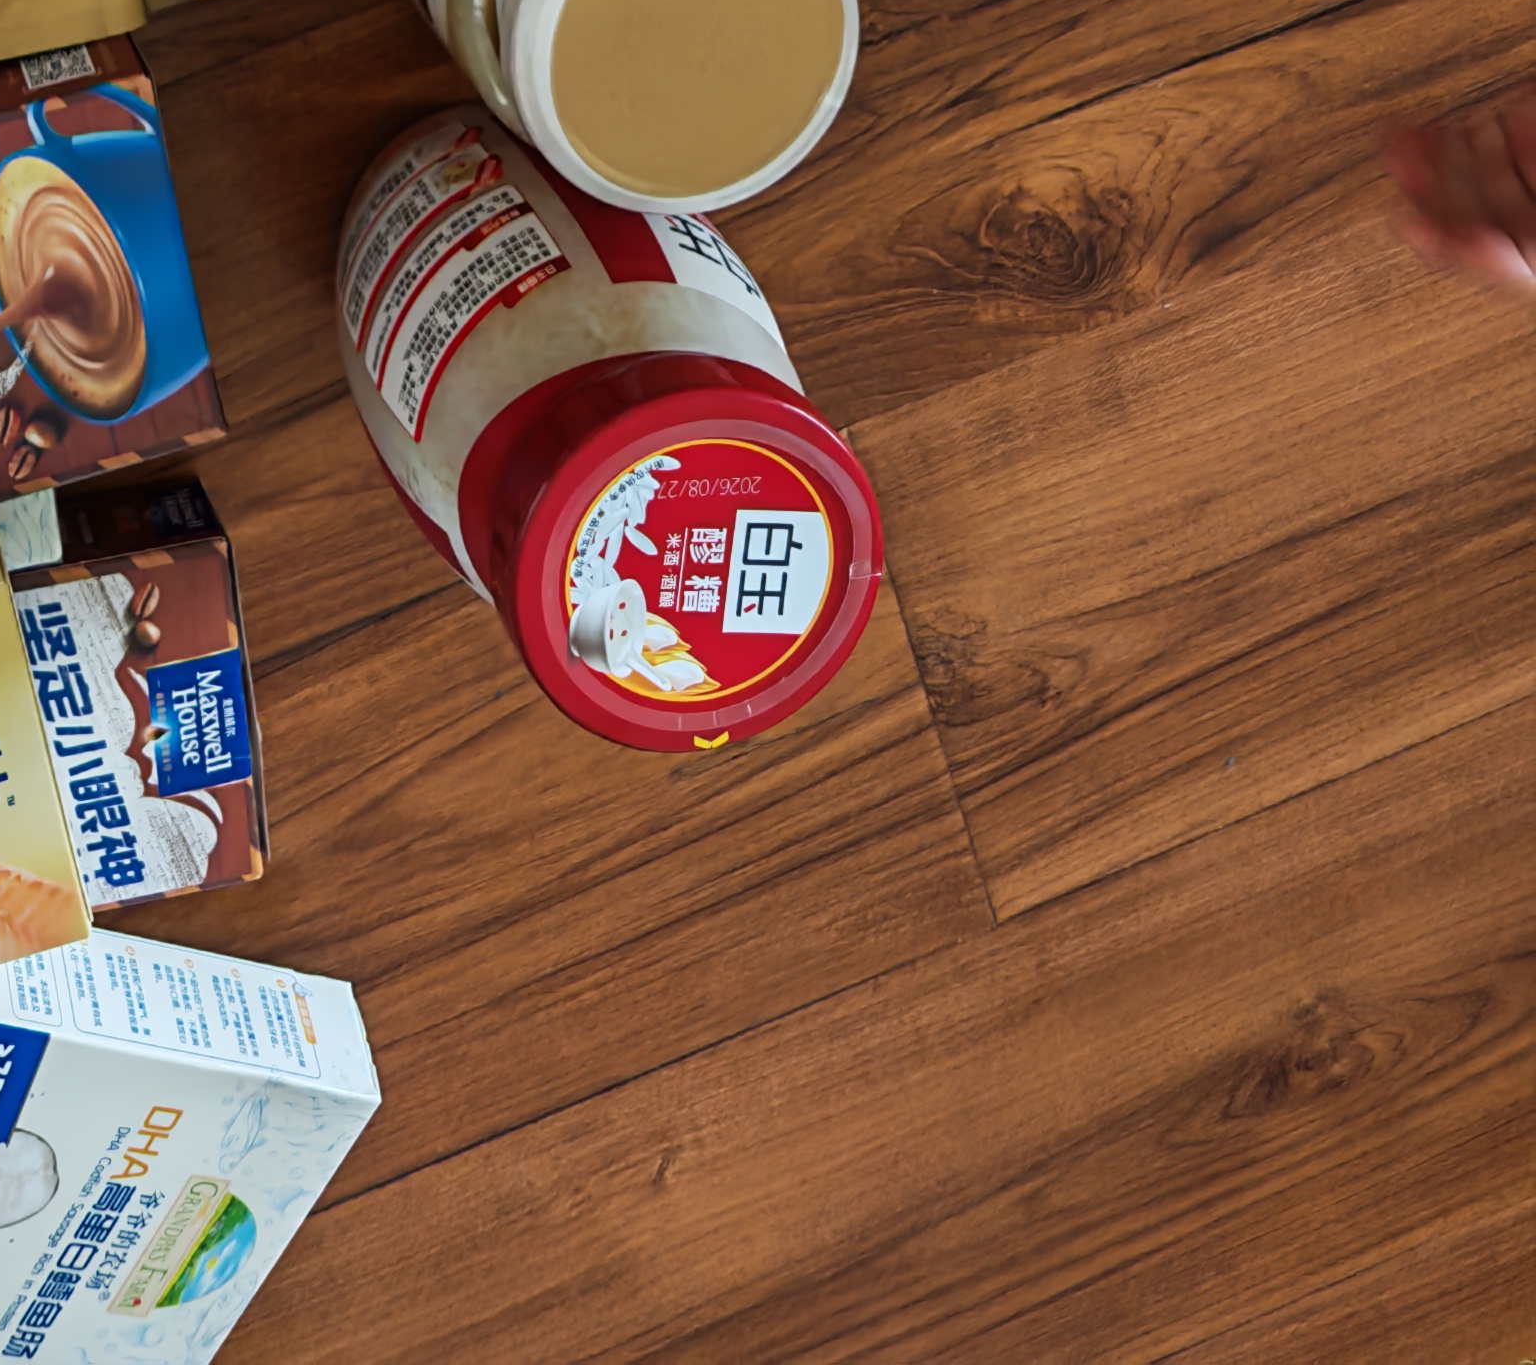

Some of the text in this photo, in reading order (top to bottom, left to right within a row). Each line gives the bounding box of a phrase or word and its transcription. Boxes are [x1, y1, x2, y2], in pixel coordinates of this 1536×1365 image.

[653, 475, 762, 497] 2026/08/27
[682, 527, 727, 613] 醪糟
[735, 522, 803, 617] 白玉
[17, 599, 148, 891] 坚定小眼神
[170, 685, 202, 766] House
[196, 666, 233, 773] Maxwell
[103, 1121, 131, 1155] DHA
[75, 1153, 112, 1201] Codfish
[43, 1198, 84, 1251] Sausage
[81, 1183, 167, 1299] 爷爷的农场
[16, 1273, 37, 1294] in
[26, 1248, 53, 1278] Rich
